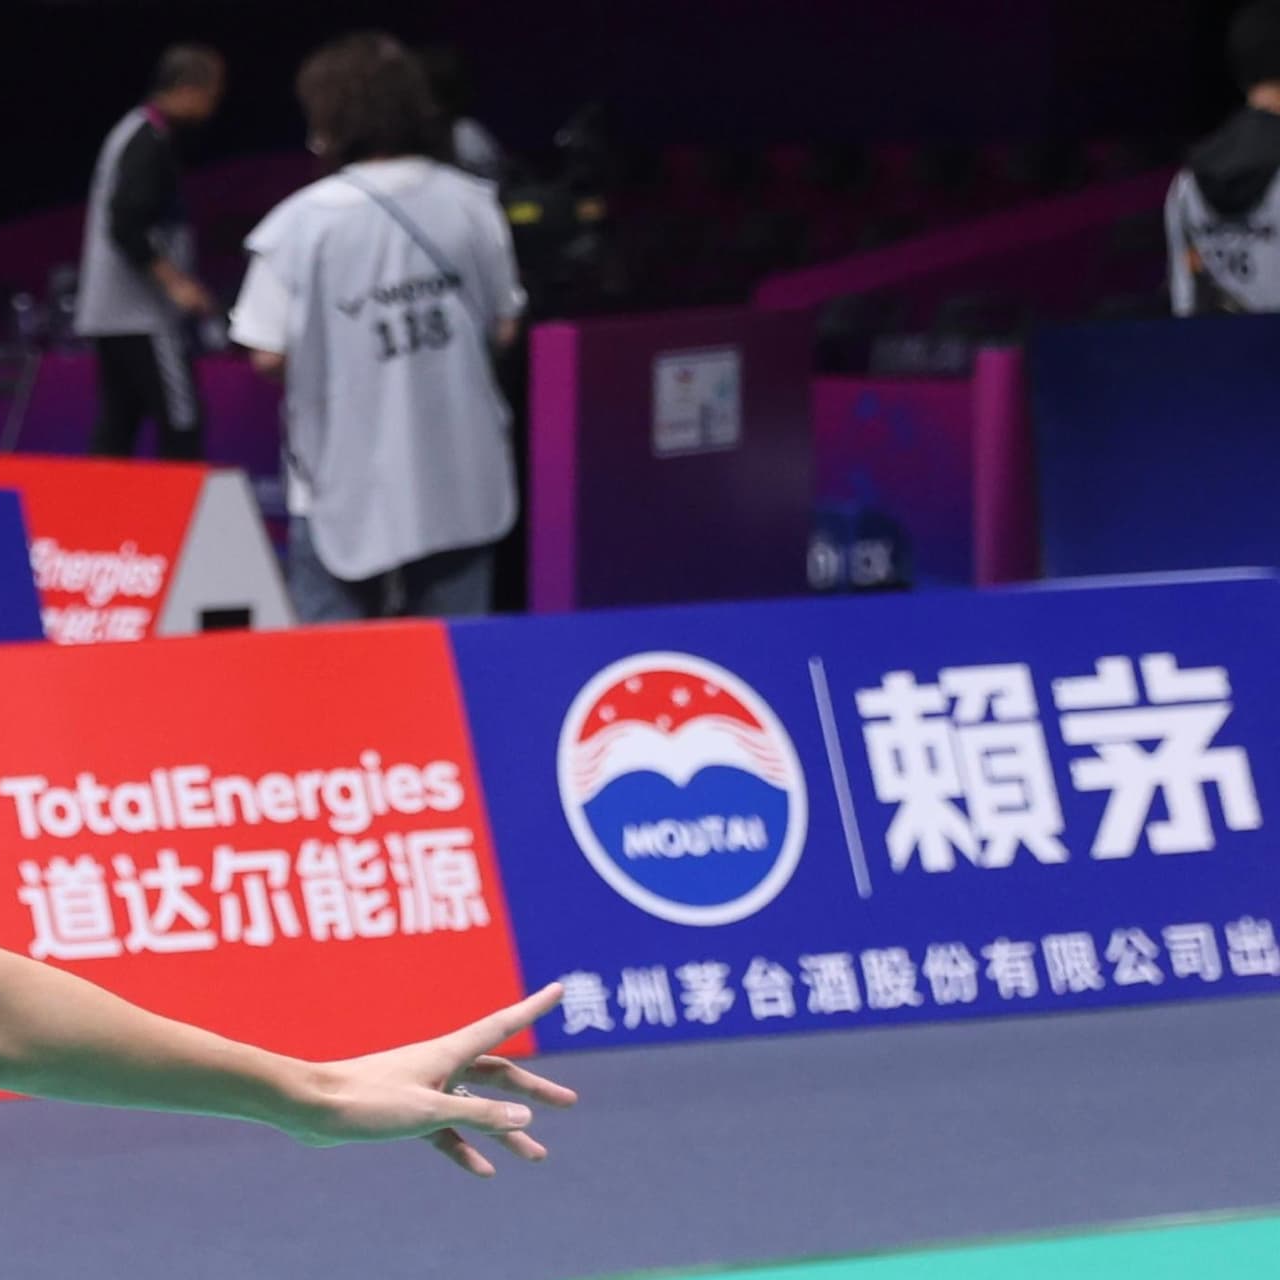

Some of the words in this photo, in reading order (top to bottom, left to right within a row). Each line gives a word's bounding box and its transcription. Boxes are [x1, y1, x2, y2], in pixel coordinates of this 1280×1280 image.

[623, 814, 769, 861] MOUTAI
[18, 826, 490, 962] 道达尔能源
